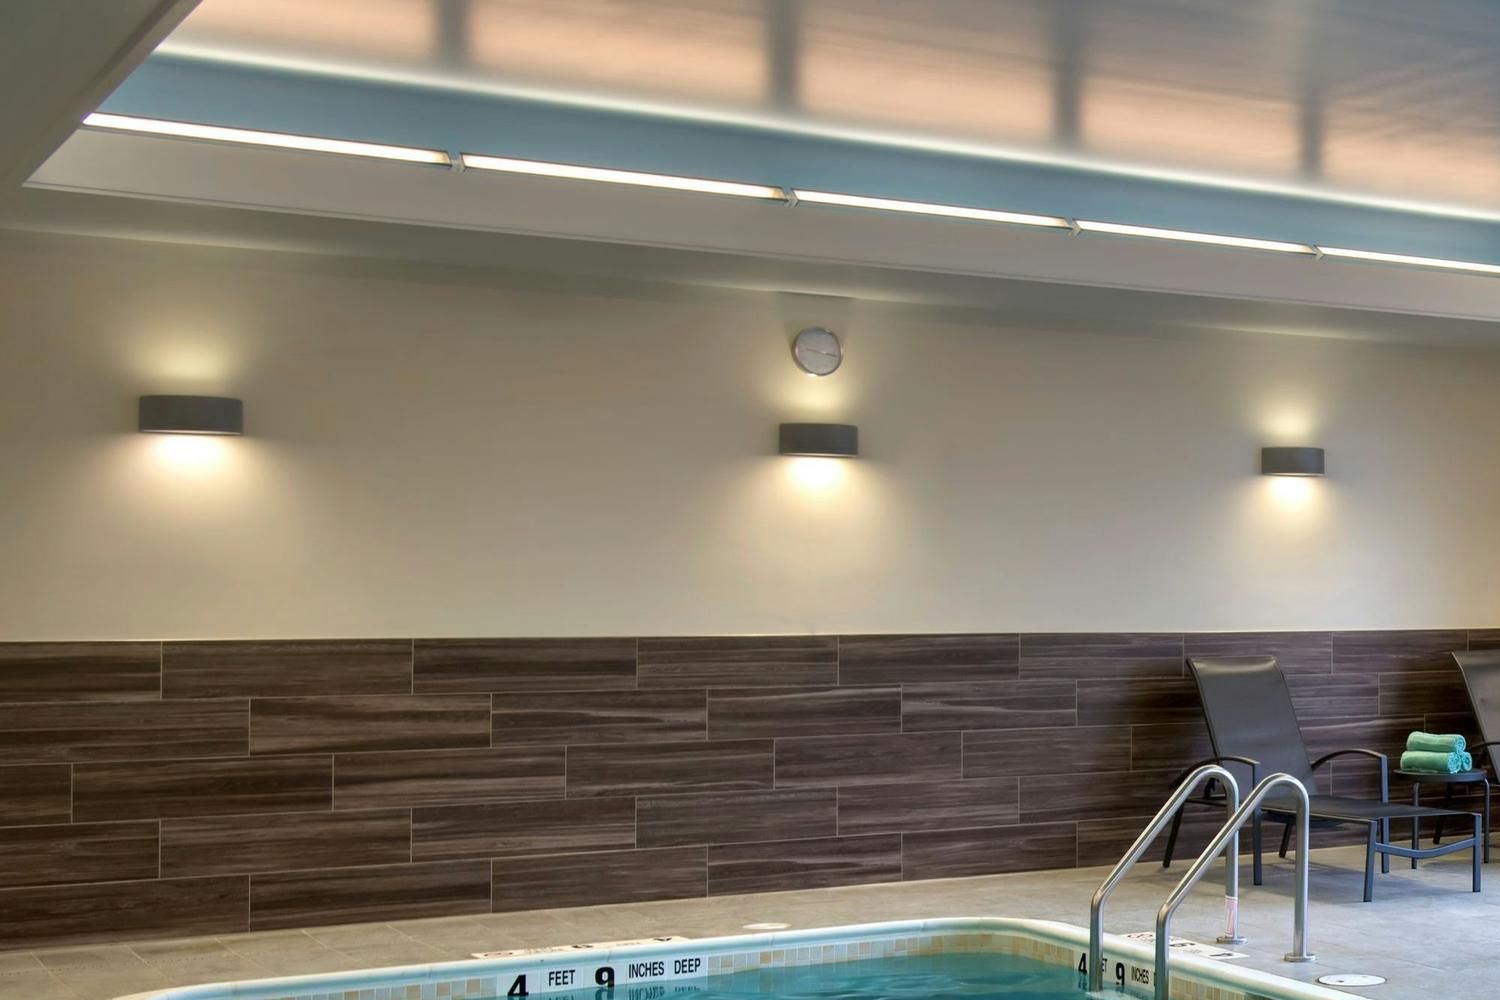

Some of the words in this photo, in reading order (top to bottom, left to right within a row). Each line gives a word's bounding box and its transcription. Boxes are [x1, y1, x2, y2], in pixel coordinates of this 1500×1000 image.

[507, 974, 529, 997] 4
[549, 969, 575, 987] FEET
[595, 966, 615, 987] 9
[628, 961, 665, 979] INCHES
[674, 958, 701, 974] DEEP
[1078, 953, 1087, 975] 4
[1116, 962, 1125, 986] 9
[1131, 966, 1149, 984] INCHES
